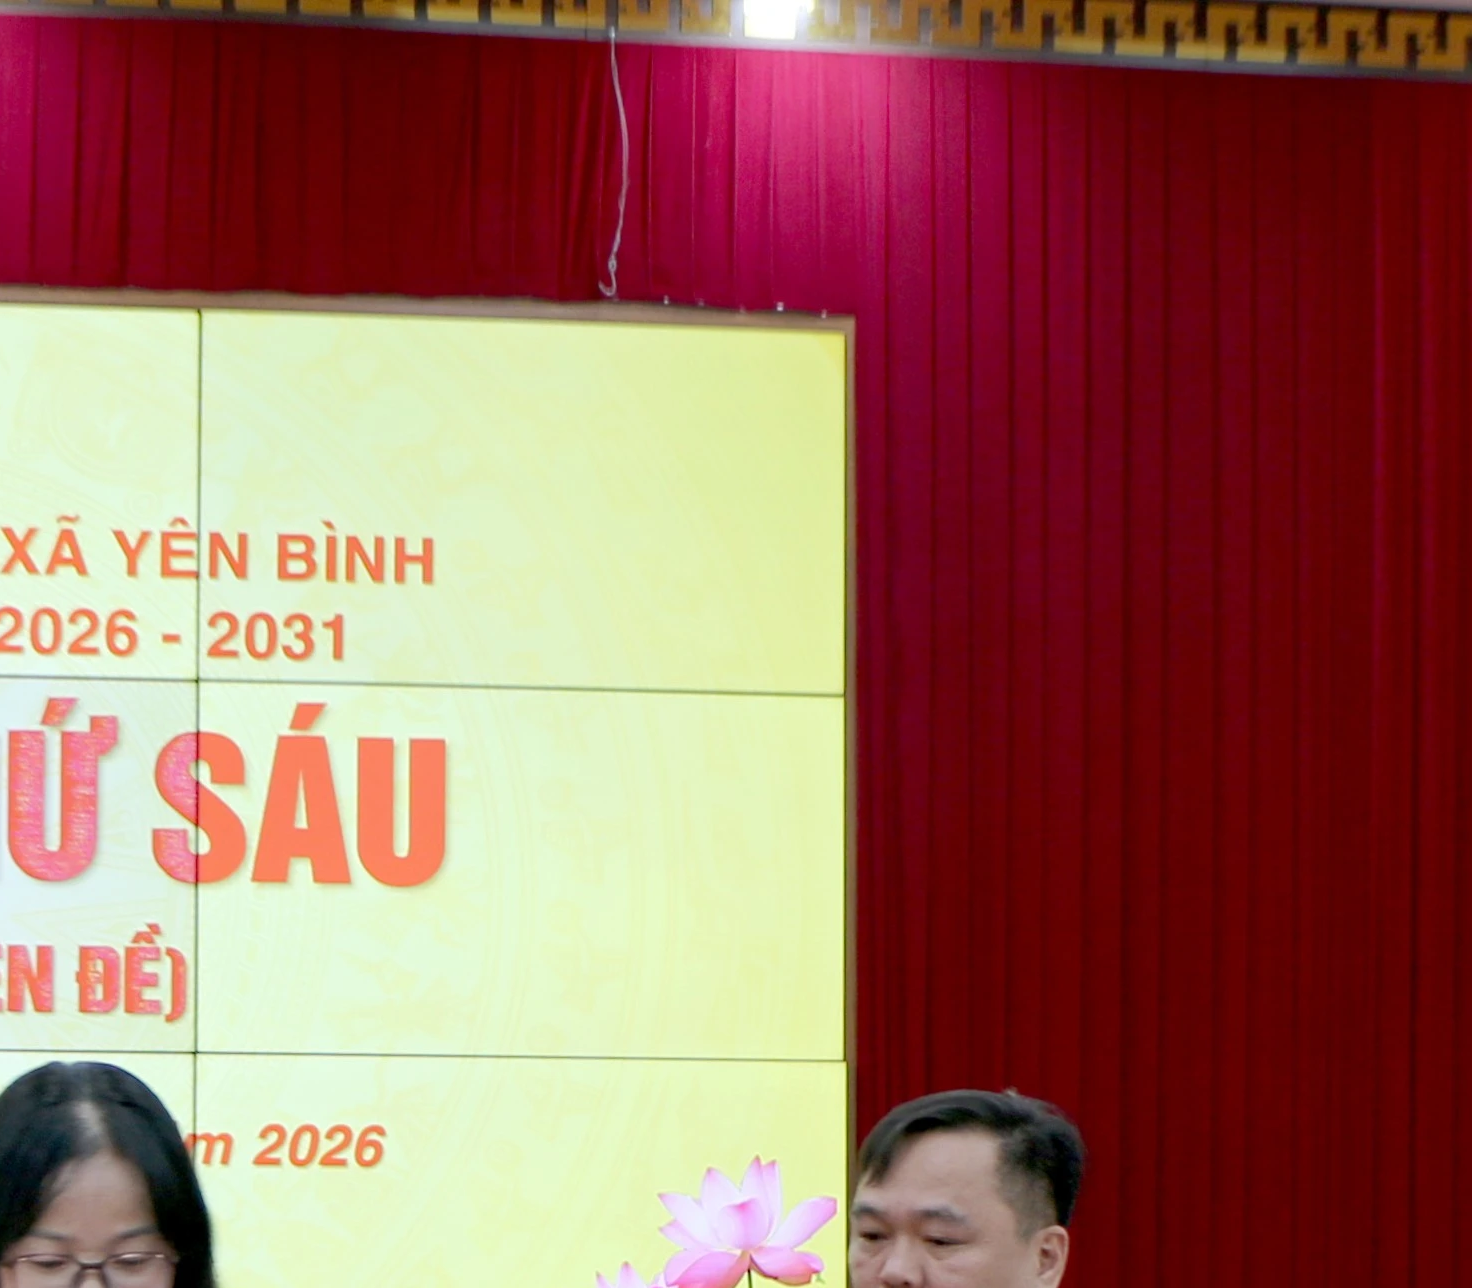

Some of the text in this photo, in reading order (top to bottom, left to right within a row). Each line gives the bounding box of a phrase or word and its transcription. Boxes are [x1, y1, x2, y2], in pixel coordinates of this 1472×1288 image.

[0, 514, 88, 576] XÃ
[112, 516, 249, 580] YÊN
[275, 520, 435, 585] BÌNH
[206, 611, 346, 662] 2031
[151, 702, 447, 888] SÁU
[75, 922, 189, 1023] ĐỀ)
[252, 1123, 387, 1168] 2026
